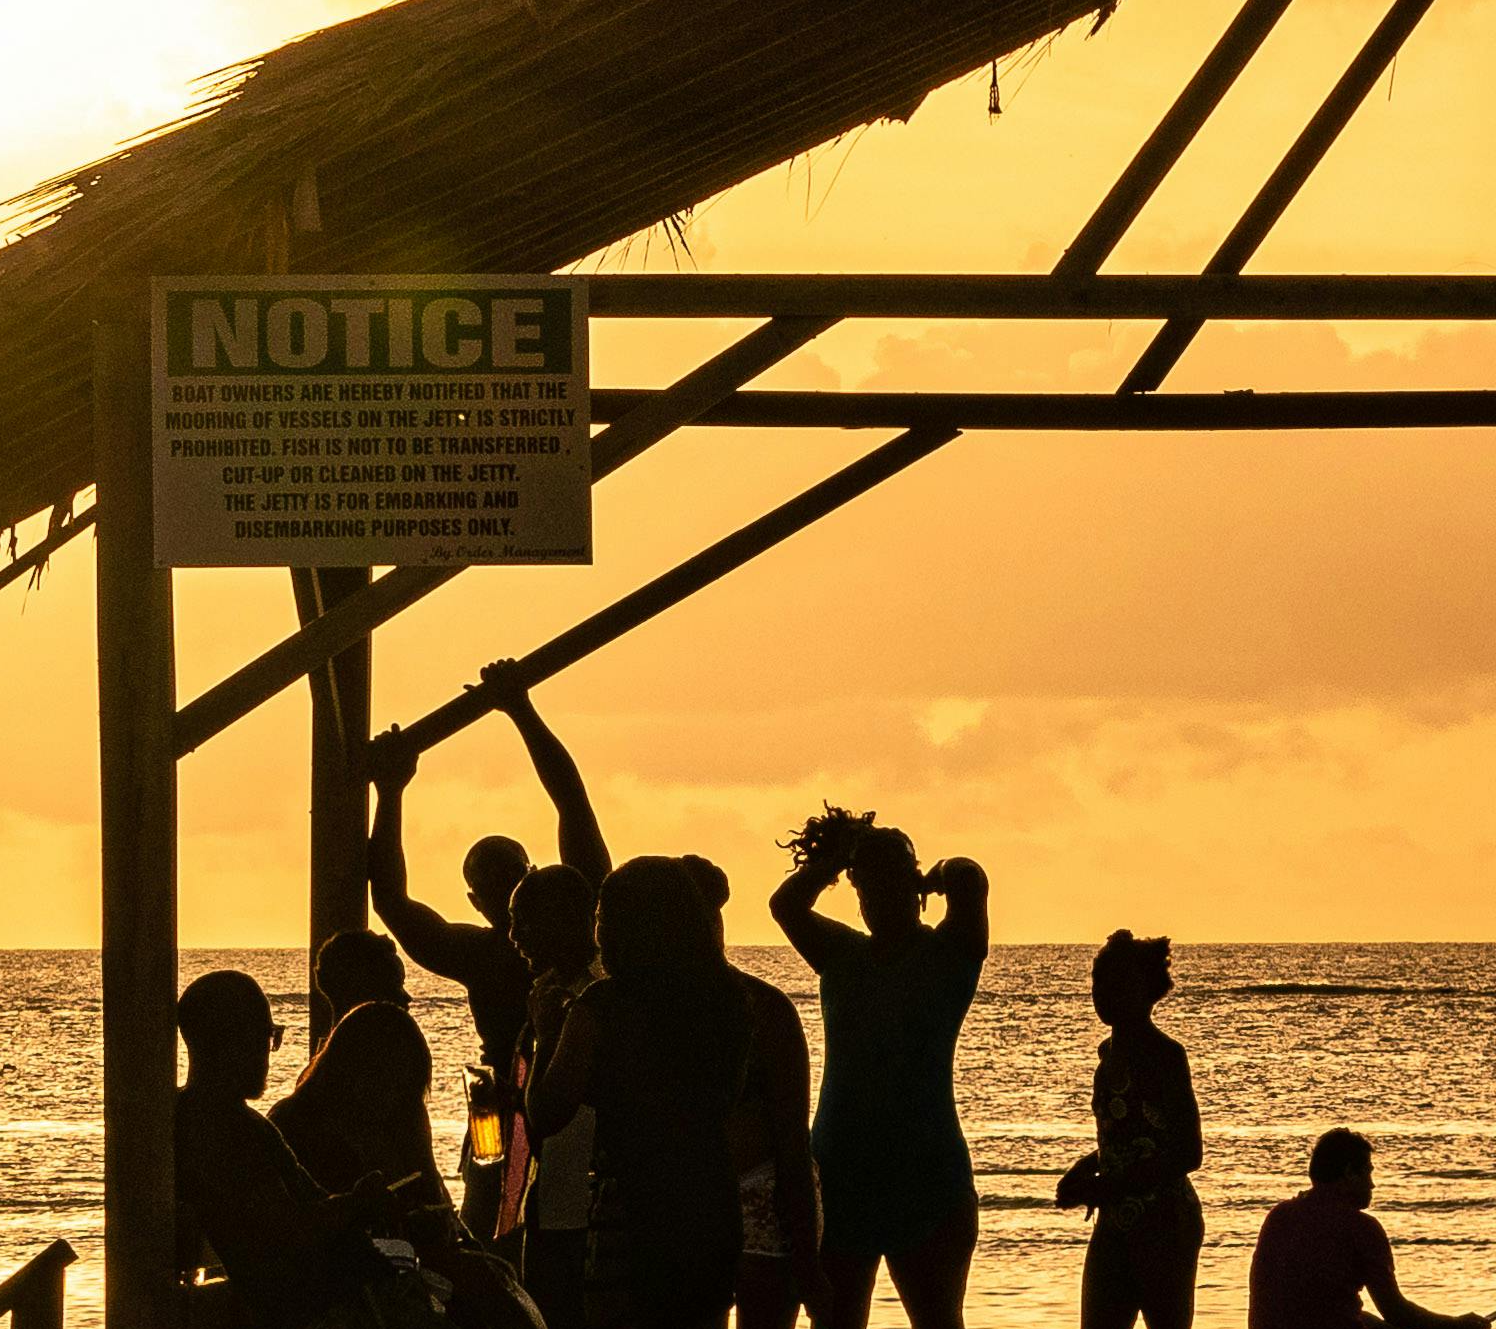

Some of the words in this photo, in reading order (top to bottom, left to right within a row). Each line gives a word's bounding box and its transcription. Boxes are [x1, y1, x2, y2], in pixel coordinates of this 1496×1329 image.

[191, 298, 545, 368] NOTICE
[172, 384, 216, 402] BOAT
[221, 383, 295, 401] OWNERS
[300, 383, 333, 400] ARE
[338, 383, 403, 400] HEREBY
[409, 383, 485, 400] NOTIFIED
[491, 382, 531, 399] THAT
[535, 382, 567, 399] THE
[165, 412, 247, 429] MOORING
[253, 412, 273, 429] OF
[278, 412, 352, 429] VESSELS
[357, 411, 383, 428] ON
[387, 411, 418, 428] THE
[423, 410, 472, 427] JETTY
[477, 410, 495, 427] IS
[500, 409, 575, 427] STRICTLY
[170, 439, 276, 457] PROHIBITED.
[282, 439, 320, 456] FISH
[326, 438, 343, 456] IS
[348, 438, 381, 455] NOT
[385, 438, 407, 454] TO
[412, 437, 434, 454] BE
[223, 466, 285, 485] CUT-UP
[290, 466, 314, 484] OR
[319, 465, 397, 484] CLEANED
[402, 465, 427, 483] ON
[432, 464, 462, 482] THE
[467, 463, 520, 483] JETTY.
[224, 494, 255, 512] THE
[260, 493, 309, 512] JETTY
[315, 493, 331, 511] IS
[337, 493, 369, 511] FOR
[375, 491, 477, 511] EMBARKING
[483, 490, 518, 509] AND
[235, 520, 366, 539] DISEMBARKING
[372, 519, 462, 538] PURPOSES
[469, 518, 515, 537] ONLY.
